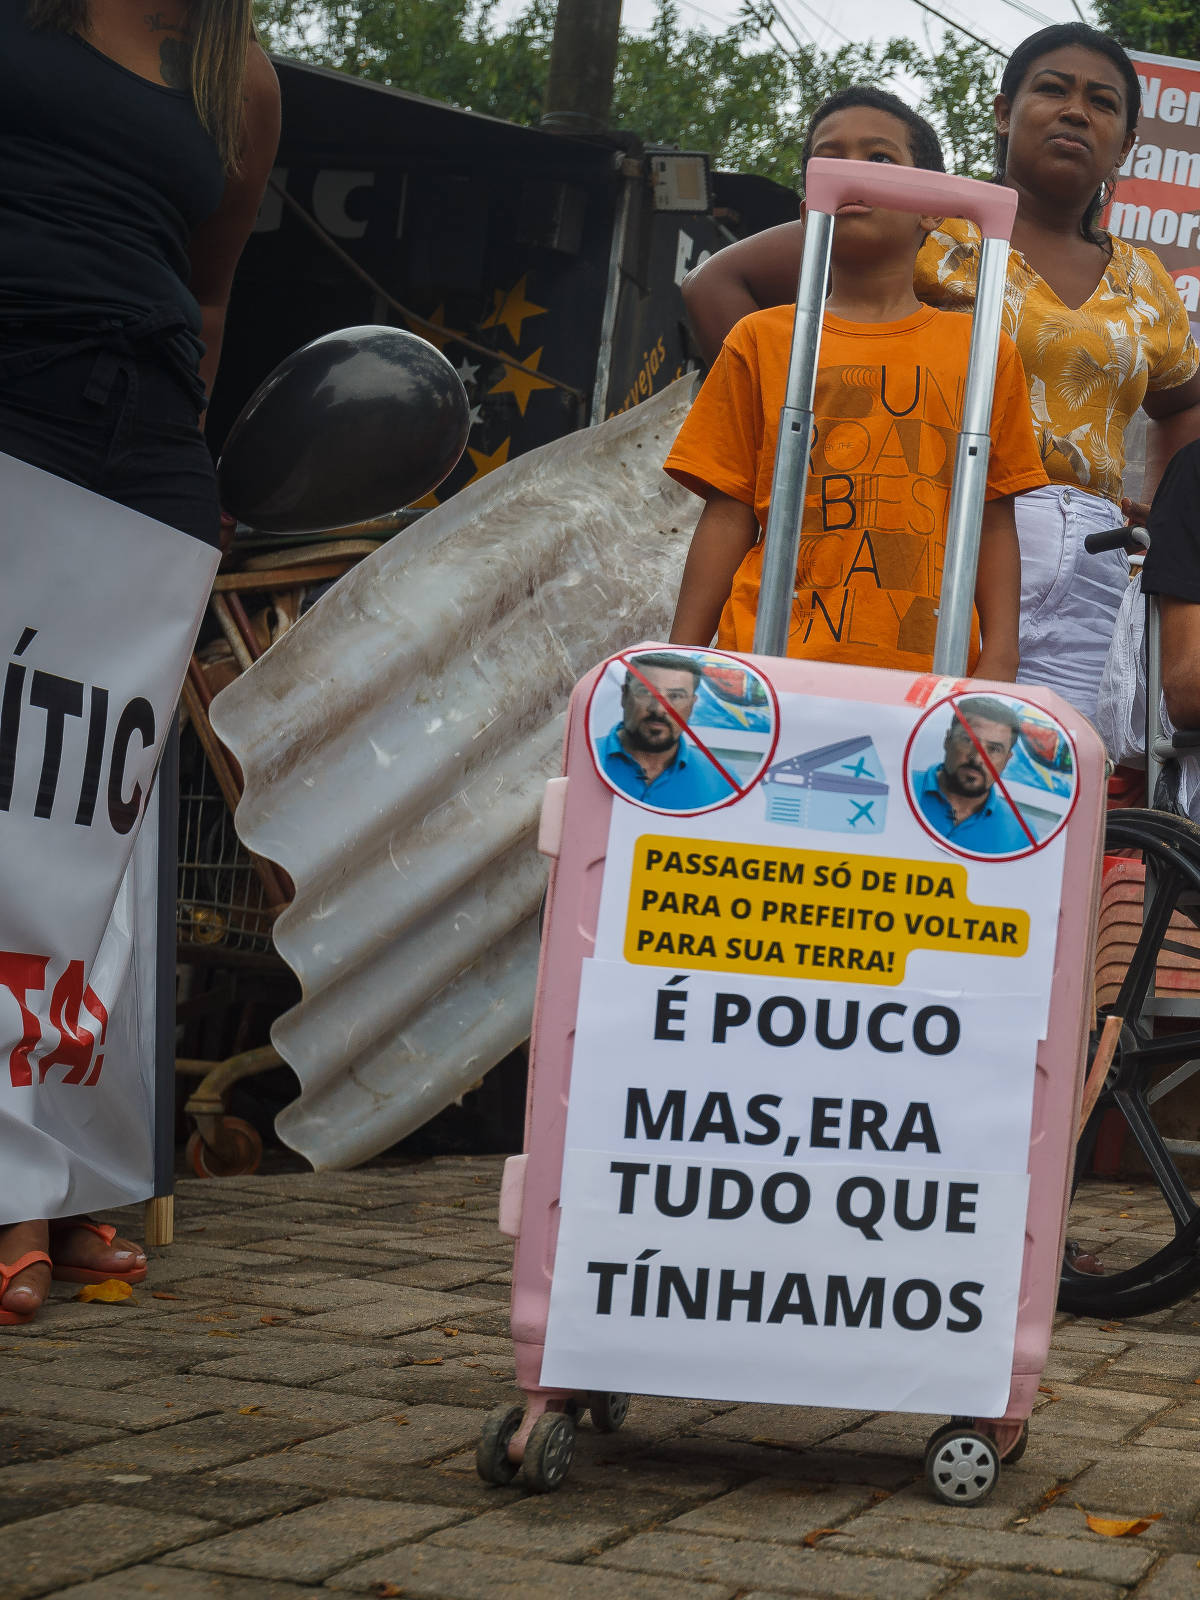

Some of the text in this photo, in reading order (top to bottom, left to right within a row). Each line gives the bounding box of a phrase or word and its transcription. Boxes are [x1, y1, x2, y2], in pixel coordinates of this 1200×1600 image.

[645, 849, 955, 899] PASSAGEM SÓ DE IDA
[640, 889, 1019, 945] PARA O PREFEITO VOLTAR
[636, 930, 895, 973] PARA SUA TERRA!
[653, 974, 961, 1056] É POUCO
[610, 1161, 979, 1241] TUDO QUE
[587, 1248, 985, 1334] TÍNHAMOS
